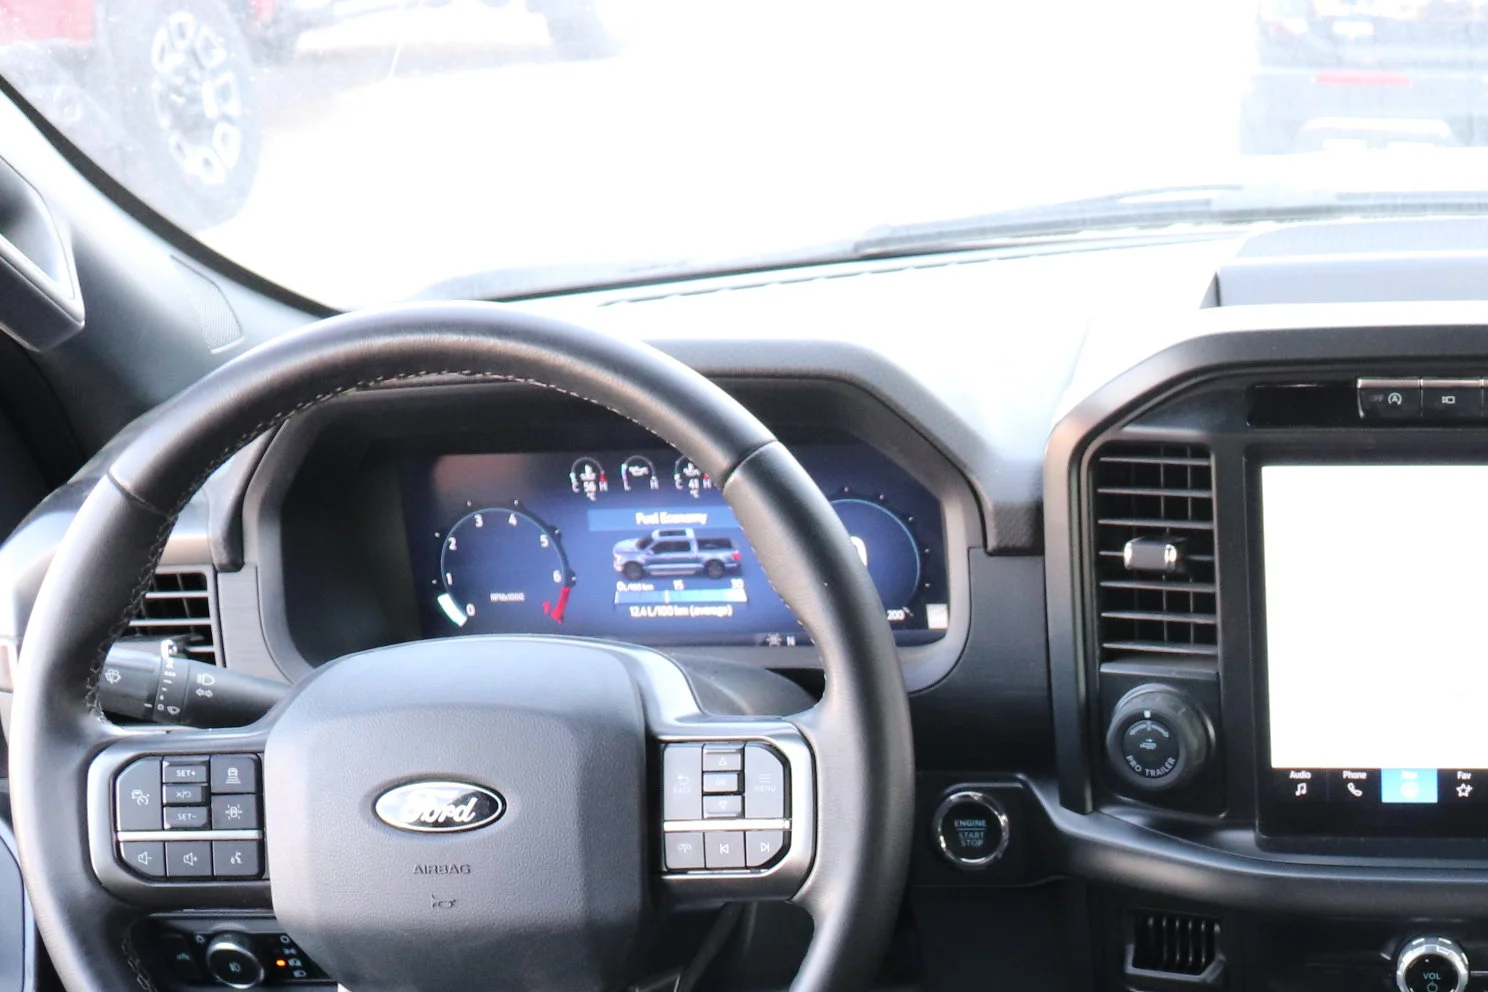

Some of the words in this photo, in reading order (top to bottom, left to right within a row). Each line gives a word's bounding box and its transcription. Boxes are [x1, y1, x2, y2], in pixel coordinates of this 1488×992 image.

[474, 514, 483, 528] 3
[508, 513, 518, 526] 4
[635, 512, 659, 525] Fuel
[659, 512, 708, 526] Economy
[448, 536, 457, 550] 2
[540, 534, 549, 548] 5
[446, 572, 453, 586] 1
[553, 570, 562, 583] 6
[466, 603, 475, 617] 0
[886, 609, 905, 621] 200
[1126, 754, 1142, 772] PRO
[1145, 756, 1176, 777] TRAILER
[1289, 770, 1312, 779] Audio
[1342, 770, 1367, 780] Phone
[1457, 771, 1472, 780] Fav
[402, 788, 478, 823] Ford
[954, 819, 987, 828] ENGINE
[958, 831, 984, 839] START
[960, 839, 984, 848] STOP
[412, 863, 471, 875] AIRBAG
[1423, 972, 1441, 980] VOL
